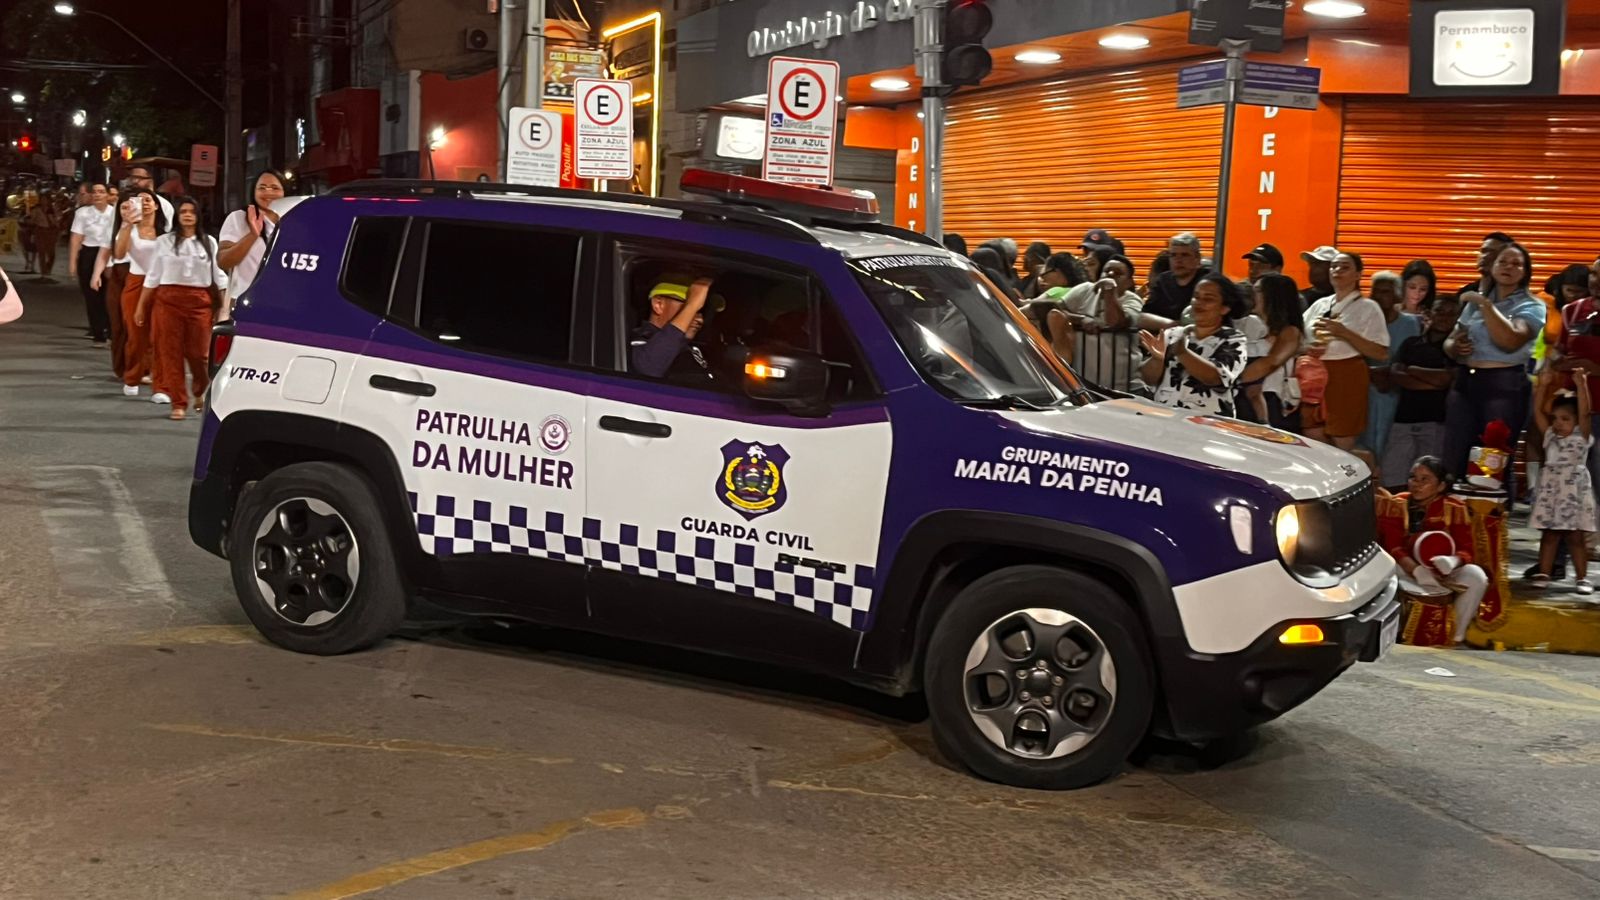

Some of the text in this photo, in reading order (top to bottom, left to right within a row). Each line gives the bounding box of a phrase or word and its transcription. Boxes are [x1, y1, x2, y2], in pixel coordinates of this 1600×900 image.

[1440, 24, 1528, 36] Pernambuco
[597, 94, 609, 115] E
[794, 81, 811, 108] E
[530, 122, 542, 142] E
[772, 136, 826, 147] ZONA AZUL
[562, 142, 572, 182] Popular
[908, 136, 920, 232] DENT
[291, 253, 319, 272] 153
[229, 367, 280, 384] VTR-02
[416, 409, 531, 446] PATRULHA
[412, 440, 574, 490] DA MULHER
[1001, 446, 1130, 478] GRUPAMENTO
[954, 458, 1163, 507] MARIA DA PENHA
[680, 516, 814, 551] GUARDA CIVIL
